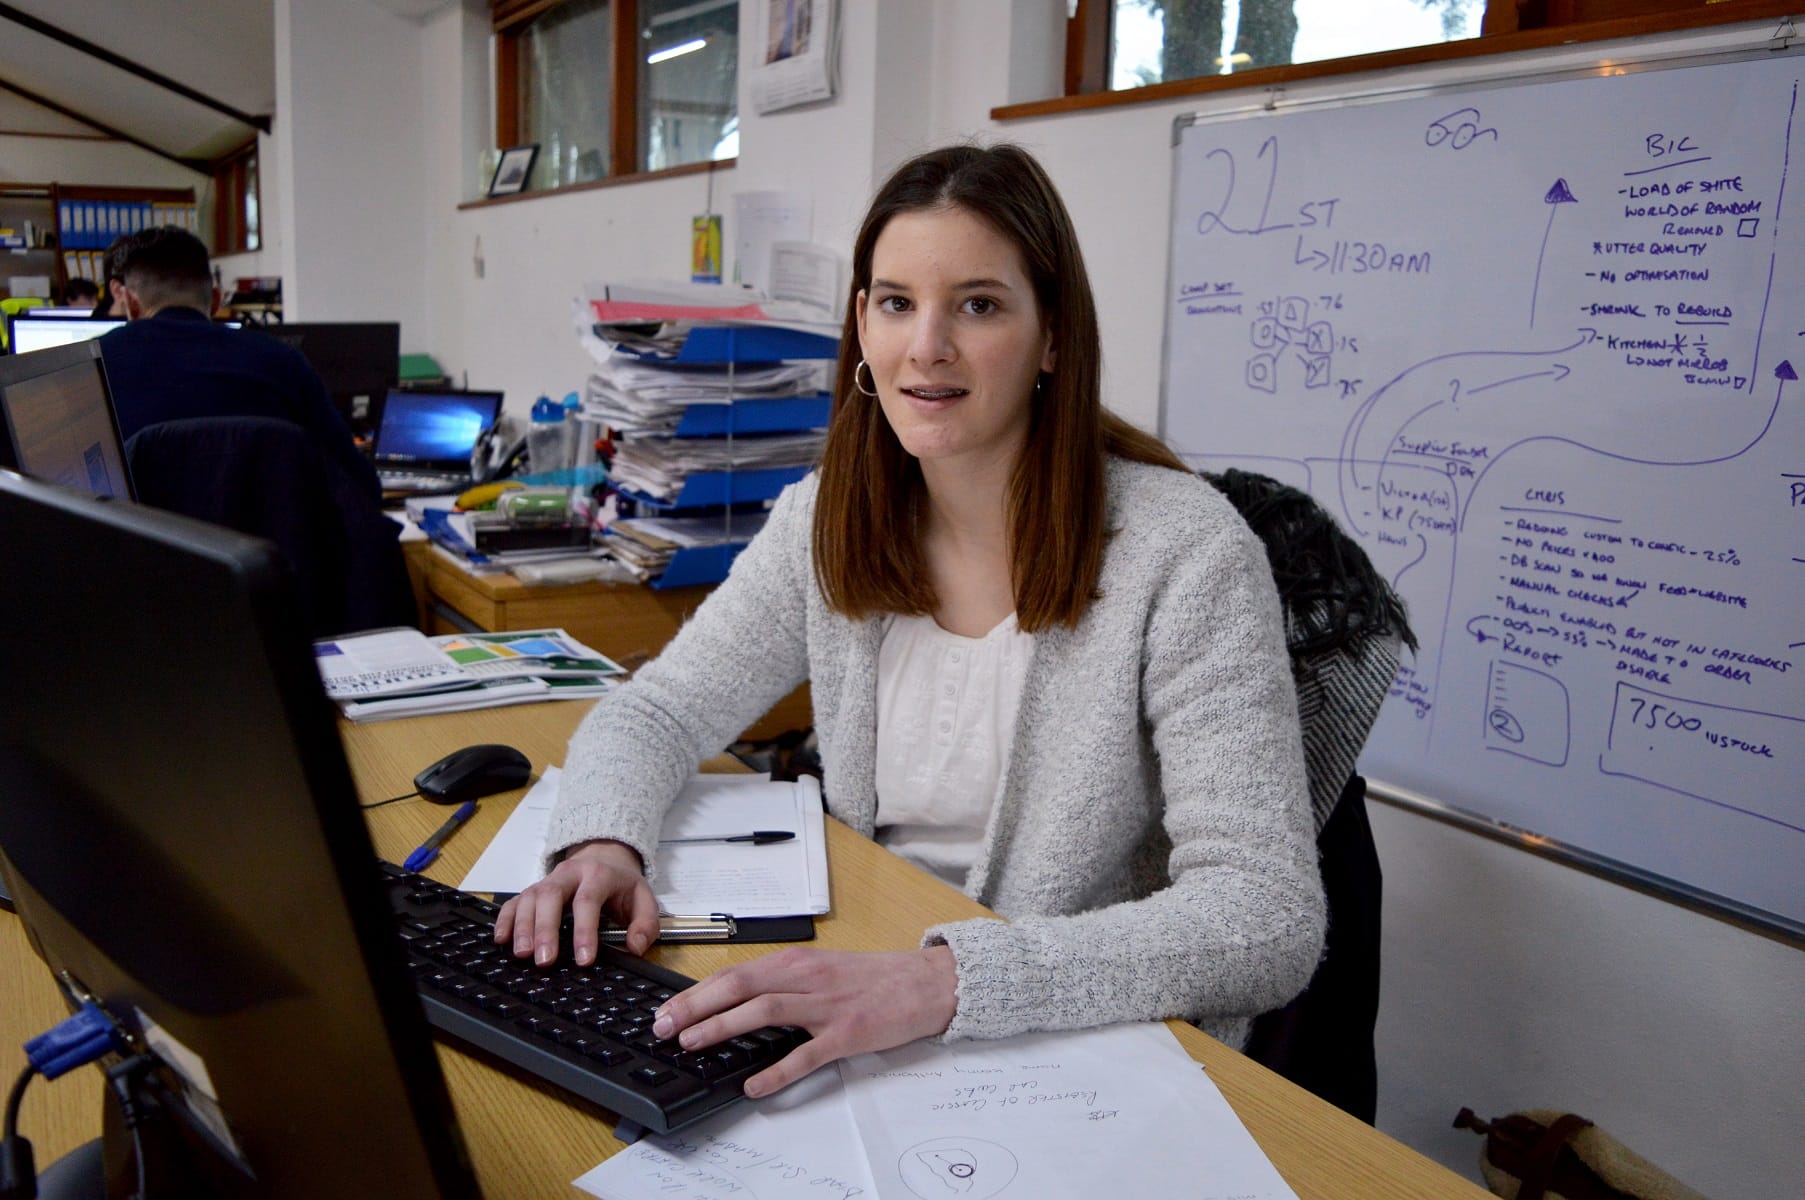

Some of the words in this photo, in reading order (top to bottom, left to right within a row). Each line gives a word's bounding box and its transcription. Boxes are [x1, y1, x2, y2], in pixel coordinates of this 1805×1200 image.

[1646, 133, 1699, 157] BIC
[1676, 181, 1693, 195] OF
[1625, 204, 1677, 217] WORLD
[1681, 203, 1699, 217] OF
[1706, 199, 1762, 215] RANDOM
[1650, 242, 1707, 256] QUALITY
[1655, 305, 1671, 316] TO
[1630, 698, 1702, 731] 7500
